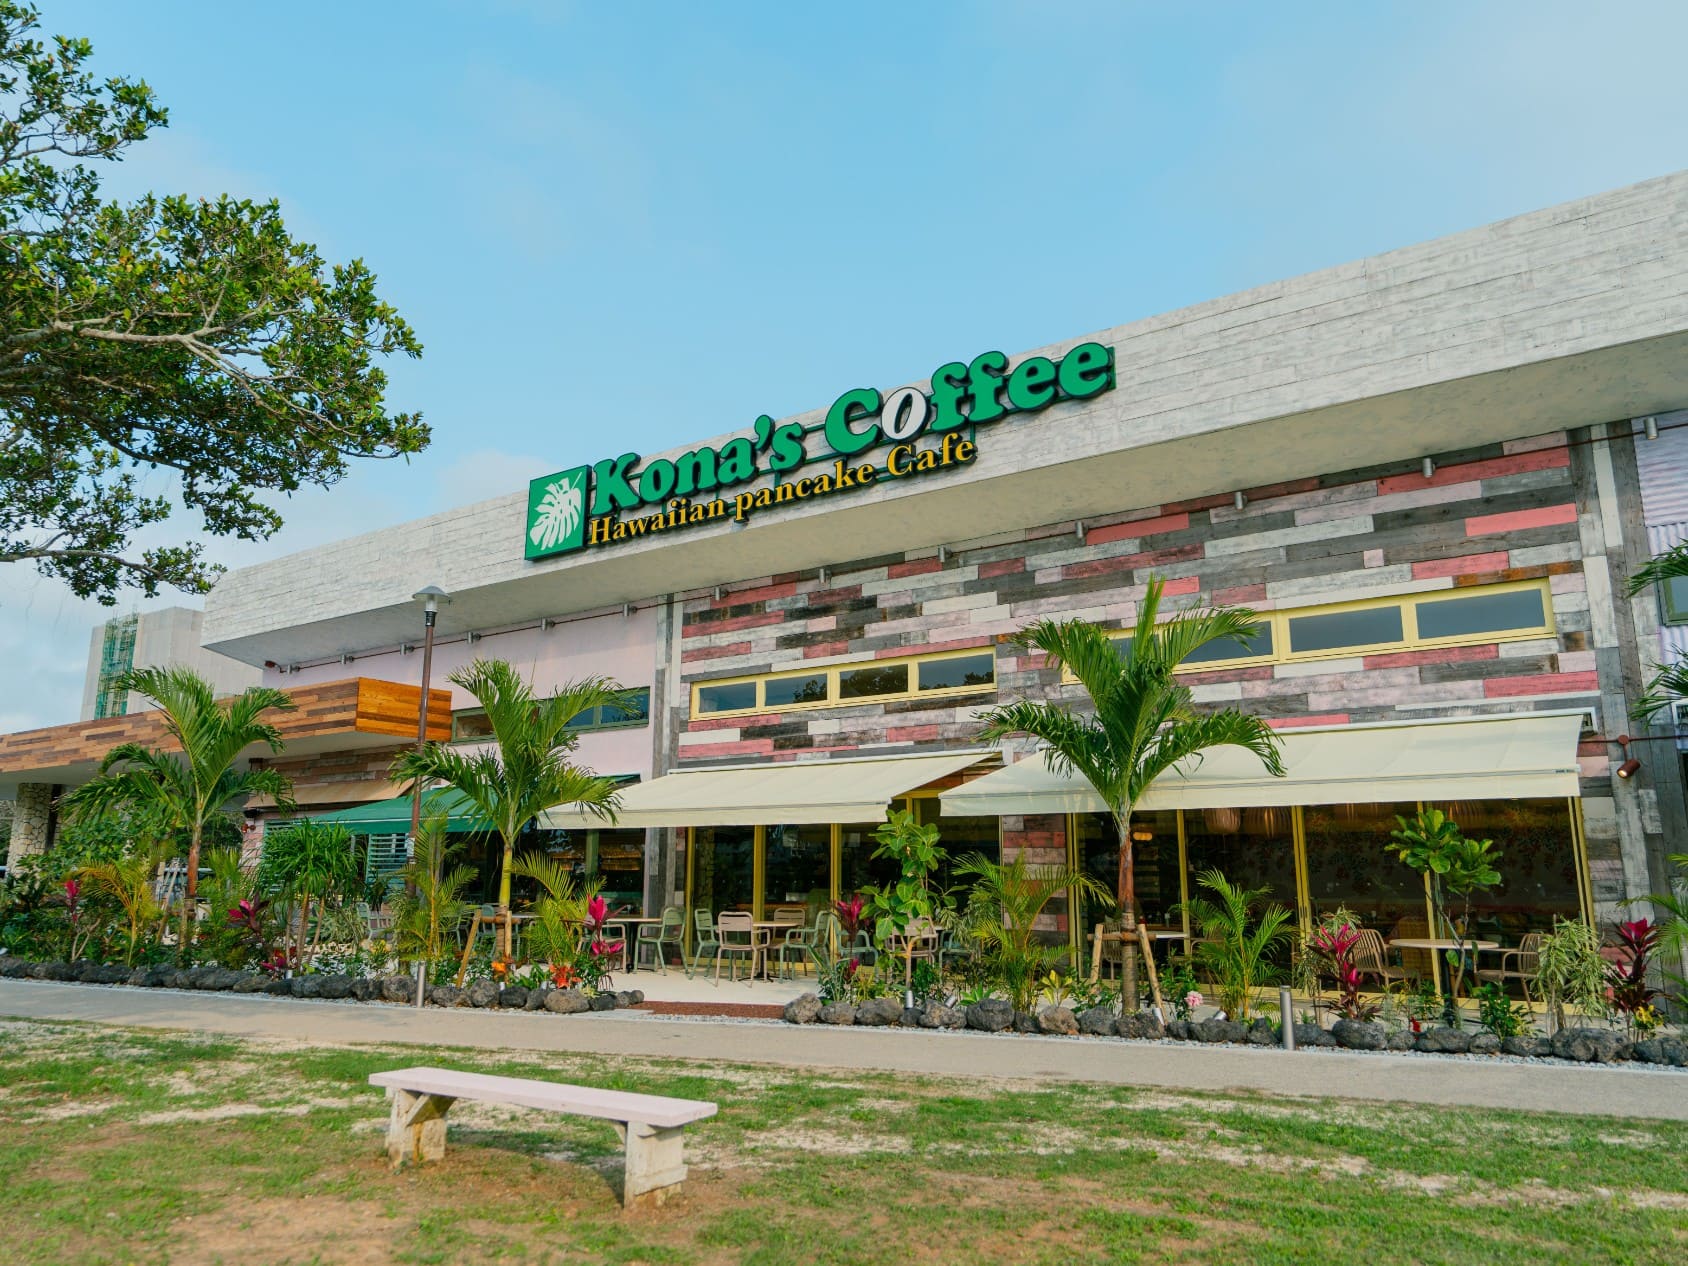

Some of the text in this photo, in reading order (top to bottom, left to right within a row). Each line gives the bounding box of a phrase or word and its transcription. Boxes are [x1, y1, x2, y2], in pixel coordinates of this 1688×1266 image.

[589, 432, 976, 545] Hawaiian pancake Cafe
[590, 342, 1113, 515] Kona's Coffee
